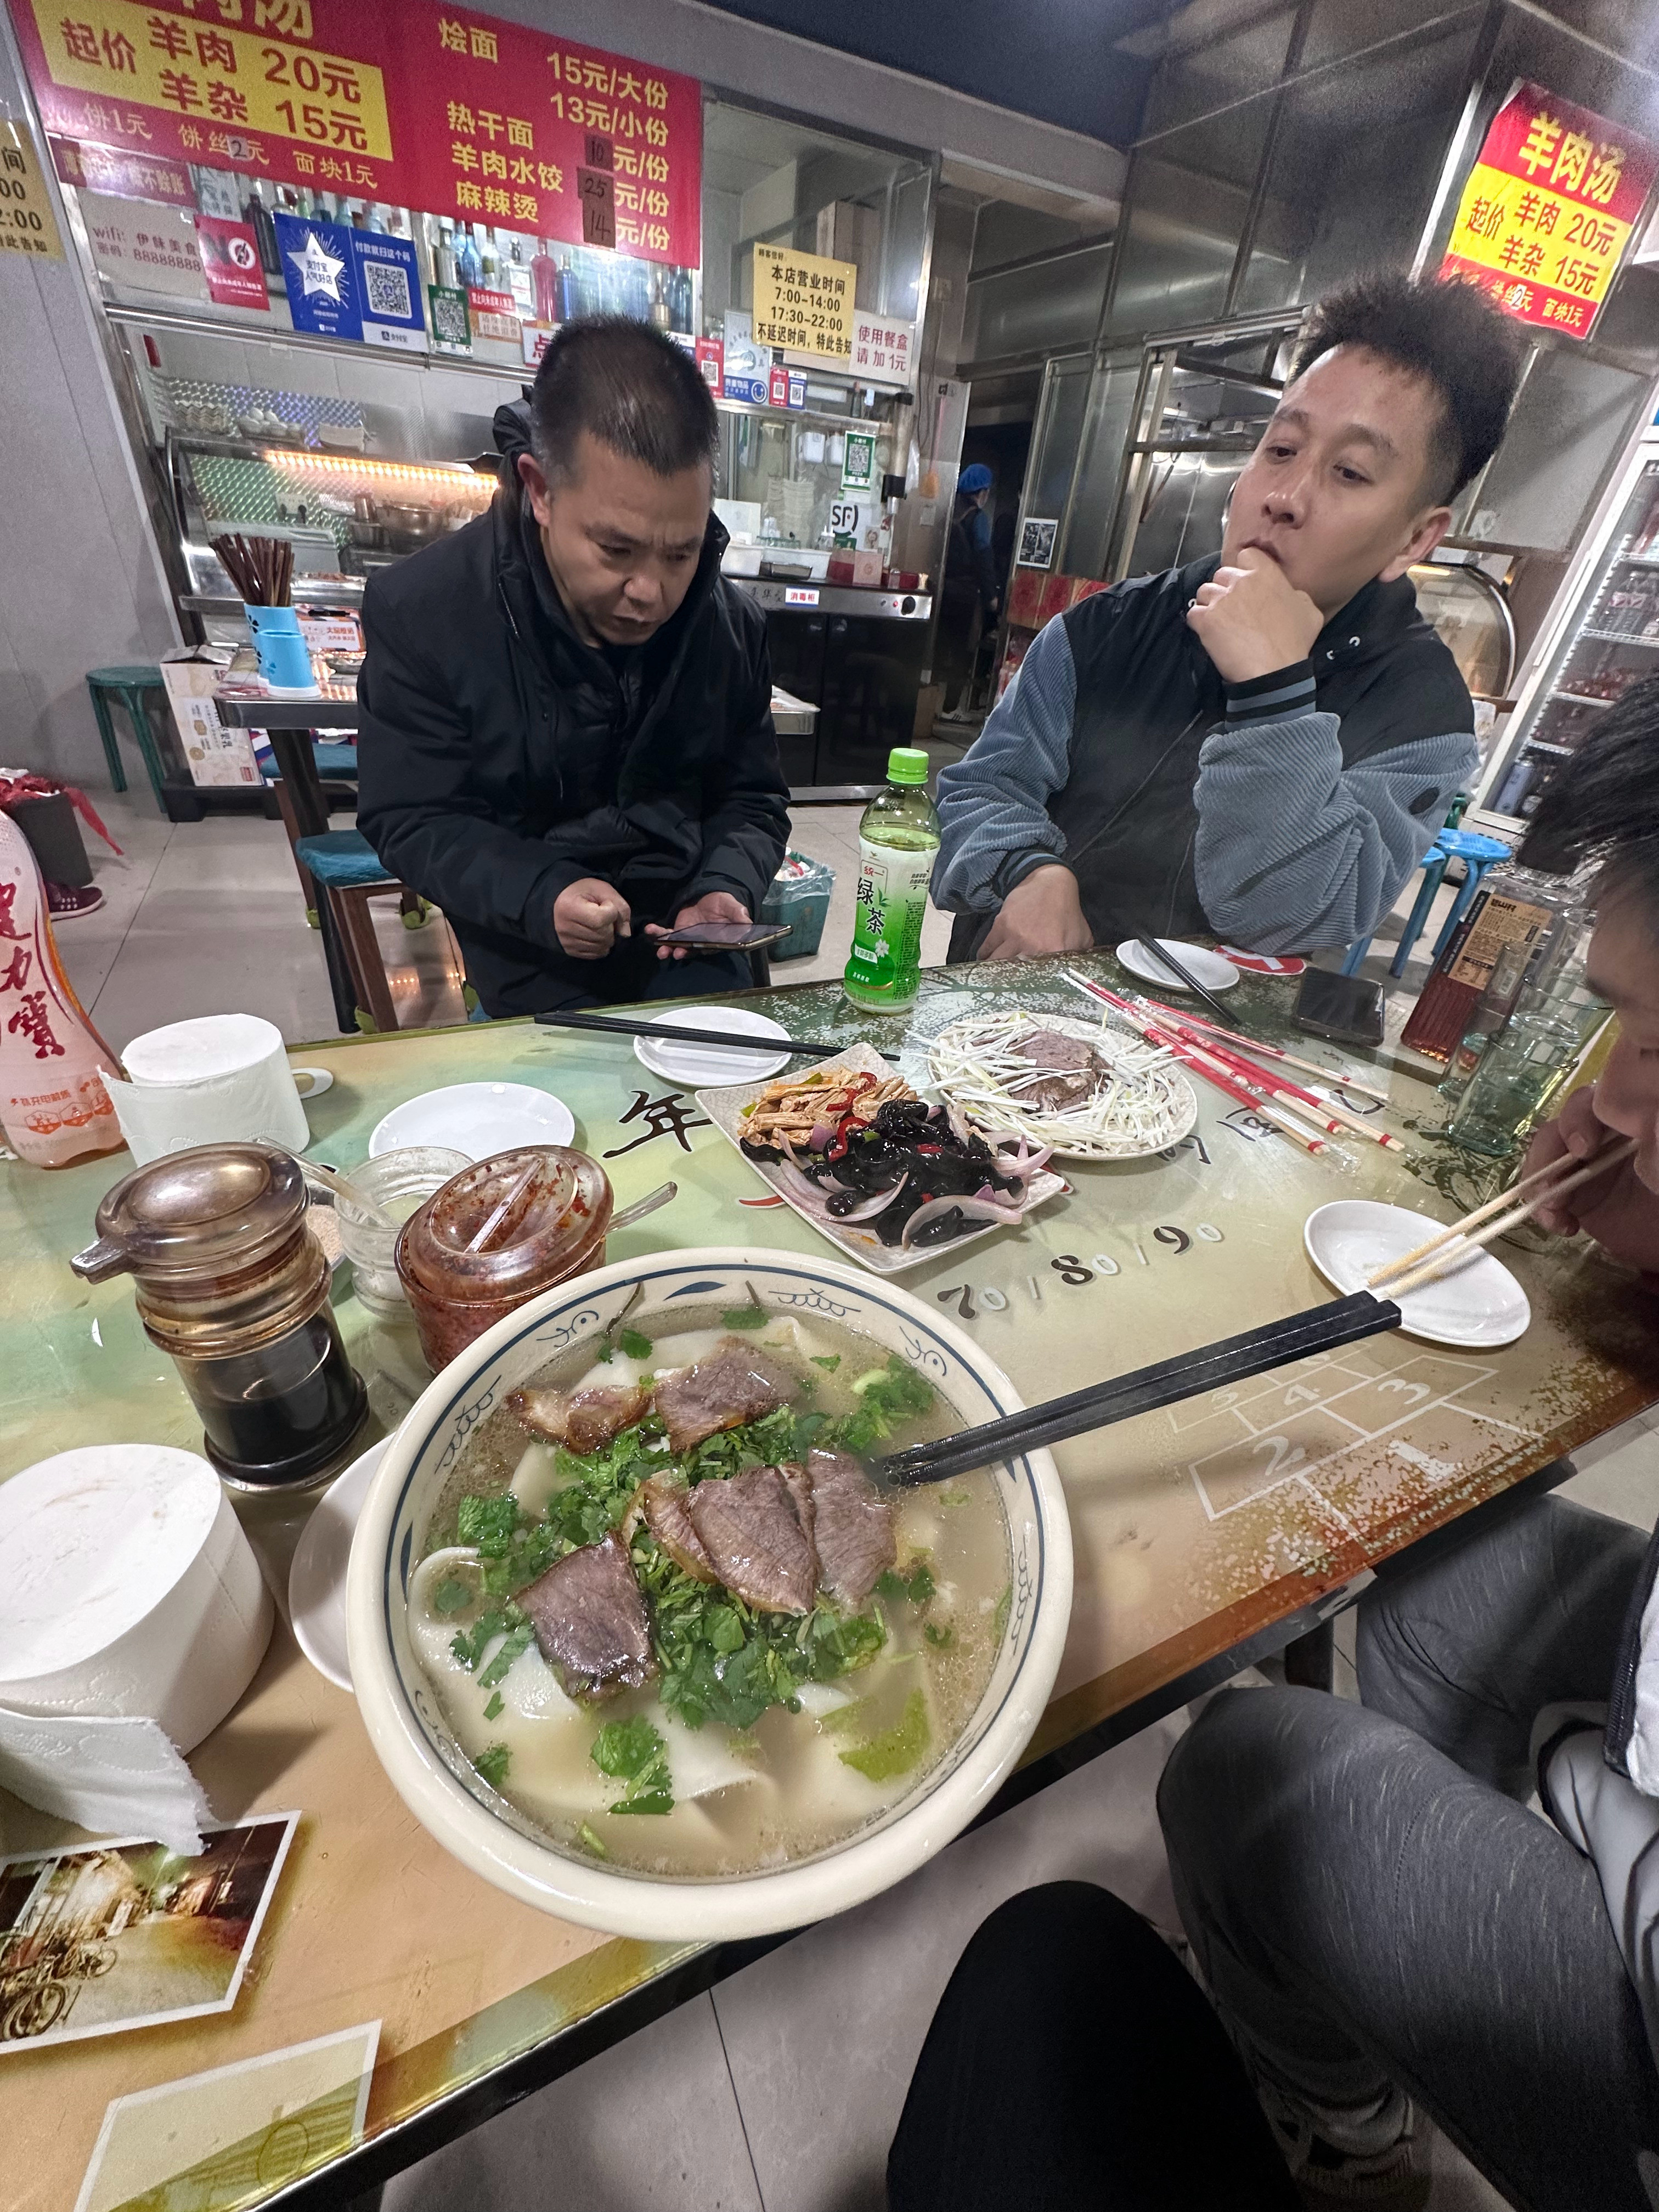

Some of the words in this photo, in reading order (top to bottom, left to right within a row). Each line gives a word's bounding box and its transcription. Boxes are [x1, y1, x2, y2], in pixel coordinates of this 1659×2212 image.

[60, 18, 137, 74] 起价
[148, 17, 238, 73] 羊肉
[262, 48, 361, 104] 20元
[439, 18, 498, 63] 烩面
[547, 52, 668, 110] 15元/大份
[159, 69, 248, 122] 羊杂
[275, 99, 368, 150] 15元
[448, 101, 533, 149] 热干面
[549, 92, 668, 147] 13元/小份
[293, 151, 377, 189] 面块1元
[452, 143, 563, 194] 羊肉水饺
[1518, 111, 1627, 204] 羊肉汤
[455, 180, 539, 222] 麻辣烫
[0, 234, 47, 252] 此告知
[1465, 196, 1505, 240] 起价
[1514, 191, 1561, 235] 羊肉
[1564, 212, 1617, 256] 20元
[133, 249, 201, 272] 88888888
[306, 259, 328, 273] 支付宝
[772, 264, 845, 296] 本店营业时间
[1499, 234, 1546, 276] 羊杂
[1555, 256, 1600, 295] 15元
[771, 306, 843, 332] 17:30-22:00
[775, 287, 840, 312] 7:00-14:00
[1542, 298, 1584, 327] 面块1元
[859, 325, 909, 351] 使用餐盒
[791, 591, 815, 602] 消毒柜
[864, 866, 884, 877] 统一
[857, 877, 885, 935] 绿茶
[602, 1090, 713, 1158] 年
[1377, 1379, 1431, 1405] 3
[1252, 1436, 1305, 1476] 2
